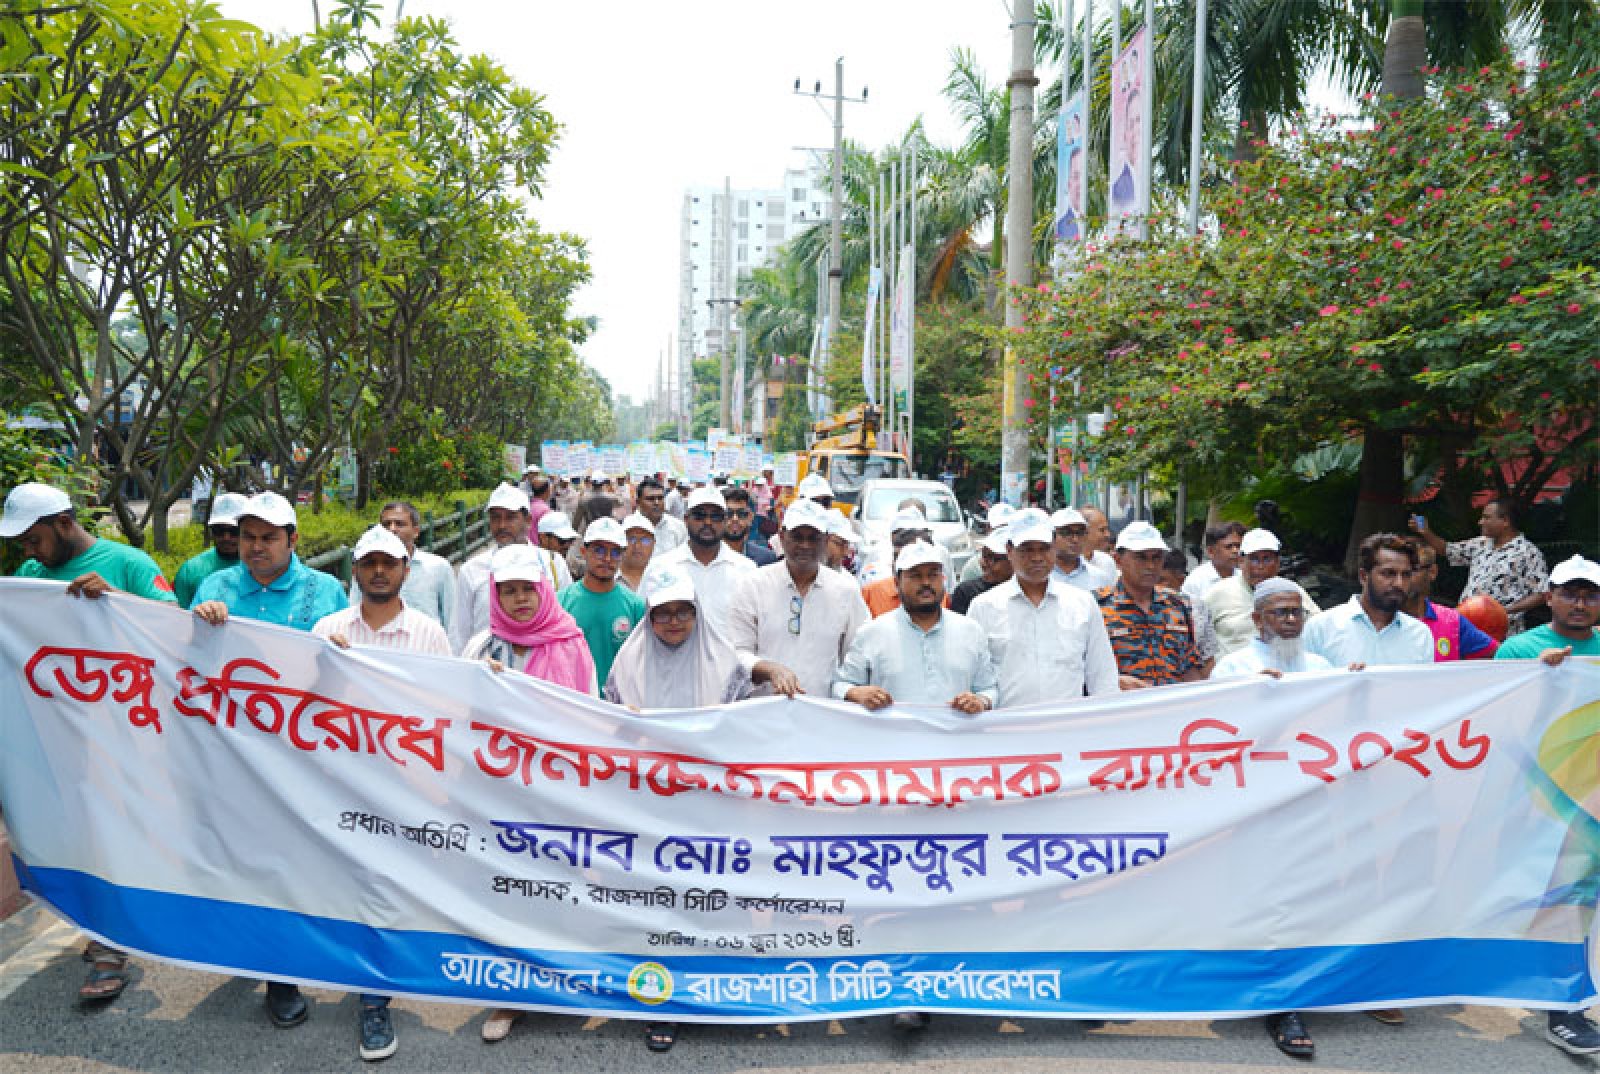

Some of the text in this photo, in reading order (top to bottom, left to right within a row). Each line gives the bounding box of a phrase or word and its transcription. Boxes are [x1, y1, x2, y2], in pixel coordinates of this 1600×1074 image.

[24, 646, 162, 735] ডেঙ্গু
[173, 658, 451, 771] প্রতিরোধে
[470, 721, 1062, 808] জনসচেতনতামলক
[338, 811, 396, 837] প্রধান
[400, 819, 470, 852] অতিথি
[490, 819, 637, 873] জনাব
[653, 834, 750, 875] মোঃ
[770, 834, 988, 893] মাহফুজুর
[1002, 833, 1168, 880] রহমান
[586, 884, 677, 908] রাজশাহী
[684, 888, 728, 912] সিটি
[735, 892, 846, 914] কর্পোরেশন
[648, 930, 696, 946] তারিখ
[716, 936, 744, 949] ০৬
[750, 934, 777, 954] জুন
[784, 931, 832, 949] ২০২৬
[684, 961, 818, 1004] রাজশাহী
[827, 960, 892, 1001] সিটি
[901, 962, 1061, 1002] কর্পোরেশন
